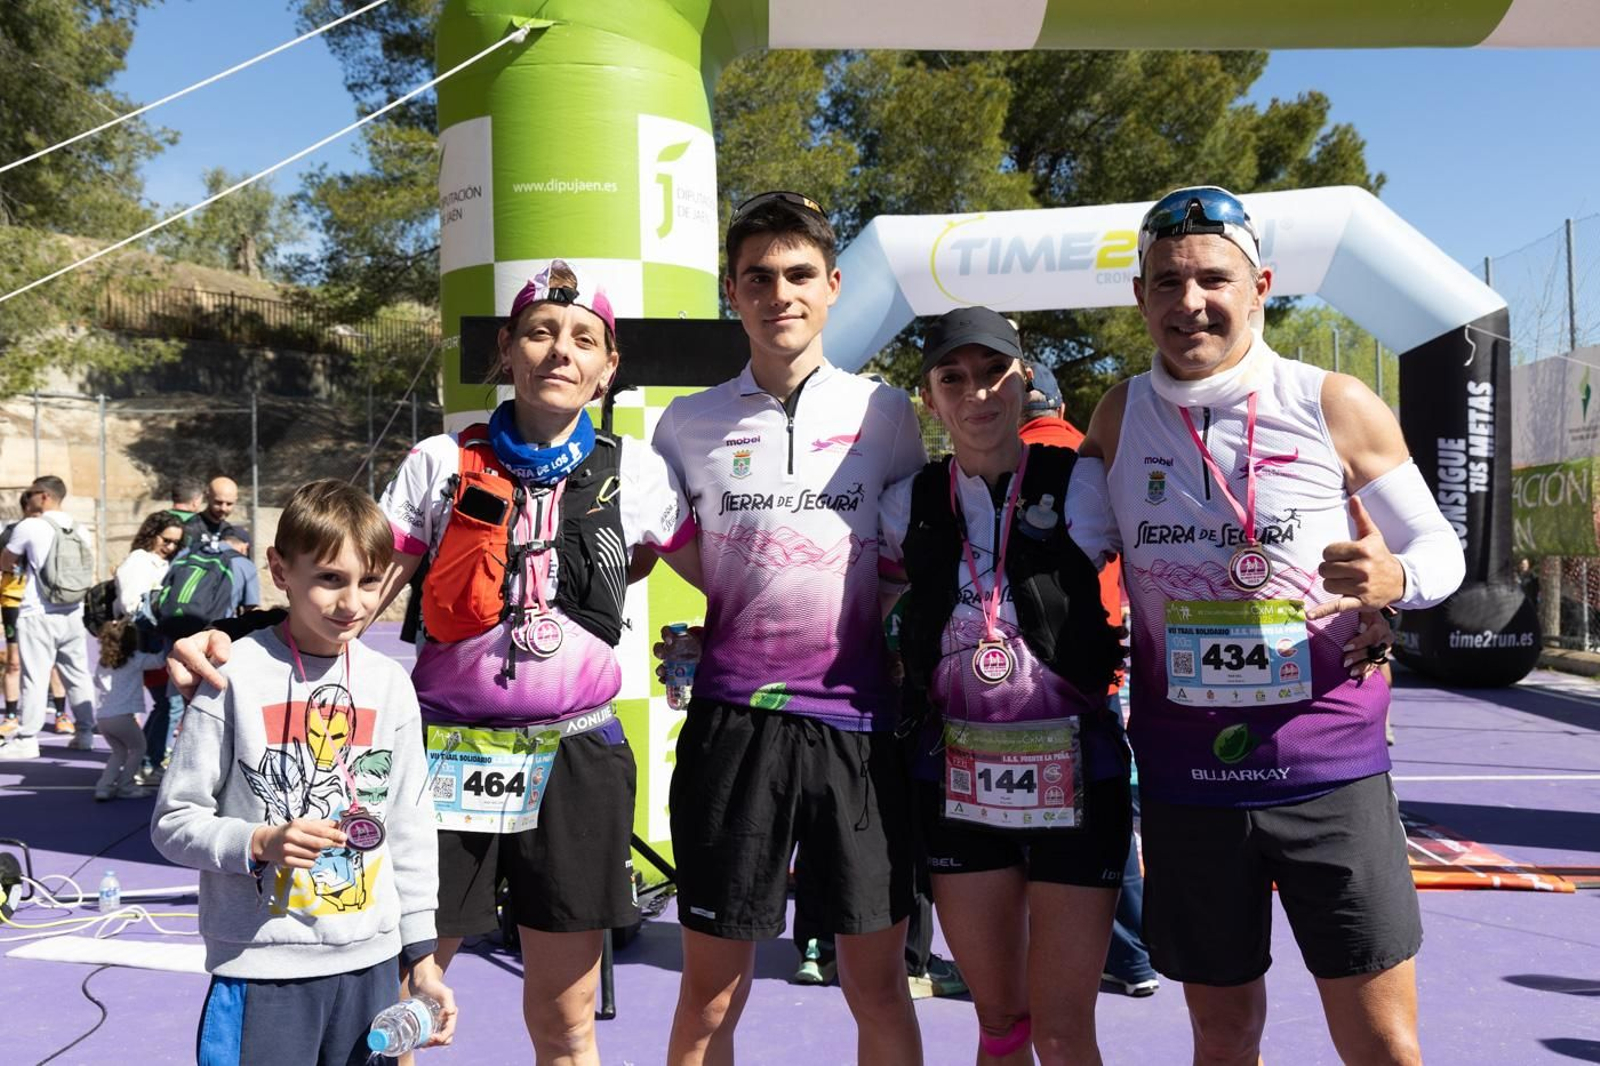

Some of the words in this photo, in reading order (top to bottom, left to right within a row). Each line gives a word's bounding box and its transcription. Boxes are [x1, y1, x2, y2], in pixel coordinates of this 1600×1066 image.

[512, 178, 618, 194] www.dipujaen.es
[1467, 380, 1494, 458] METAS
[551, 453, 569, 470] LOS
[1468, 461, 1489, 494] TUS
[1511, 464, 1588, 508] ACIÓN
[719, 490, 774, 515] SIERRA
[776, 496, 793, 507] DE
[790, 489, 859, 513] SEGURA
[1437, 437, 1468, 549] ONSIGUE
[1134, 520, 1196, 549] SIERRA
[1198, 528, 1217, 542] DE
[1195, 627, 1230, 635] SOLIDARIO
[1449, 630, 1534, 648] time2run.es
[1202, 643, 1269, 671] 434
[463, 770, 525, 798] 464
[977, 768, 1036, 794] 144
[1191, 766, 1291, 781] BUJARKAY
